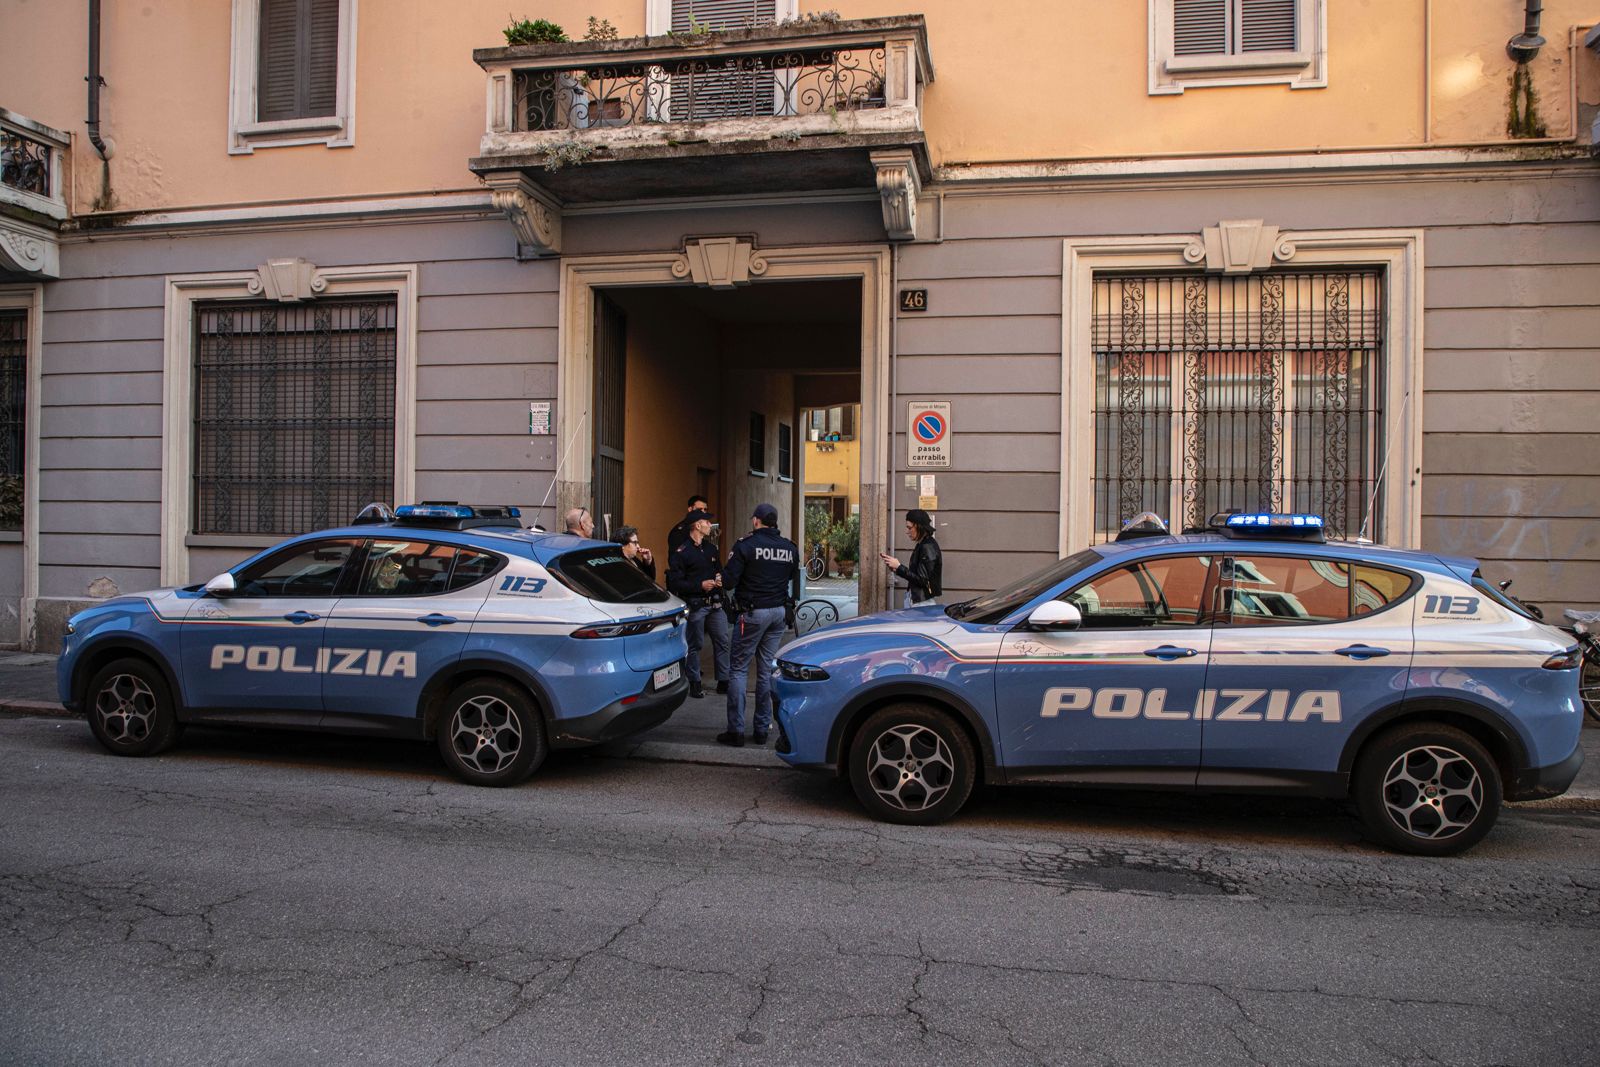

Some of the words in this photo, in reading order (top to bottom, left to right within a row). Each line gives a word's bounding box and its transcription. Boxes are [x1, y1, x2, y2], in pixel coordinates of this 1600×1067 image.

[905, 291, 924, 307] 46
[755, 547, 794, 563] POLIZIA
[499, 575, 548, 593] 113
[1423, 594, 1480, 615] 113
[210, 644, 417, 678] POLIZIA
[1039, 686, 1342, 723] POLIZIA
